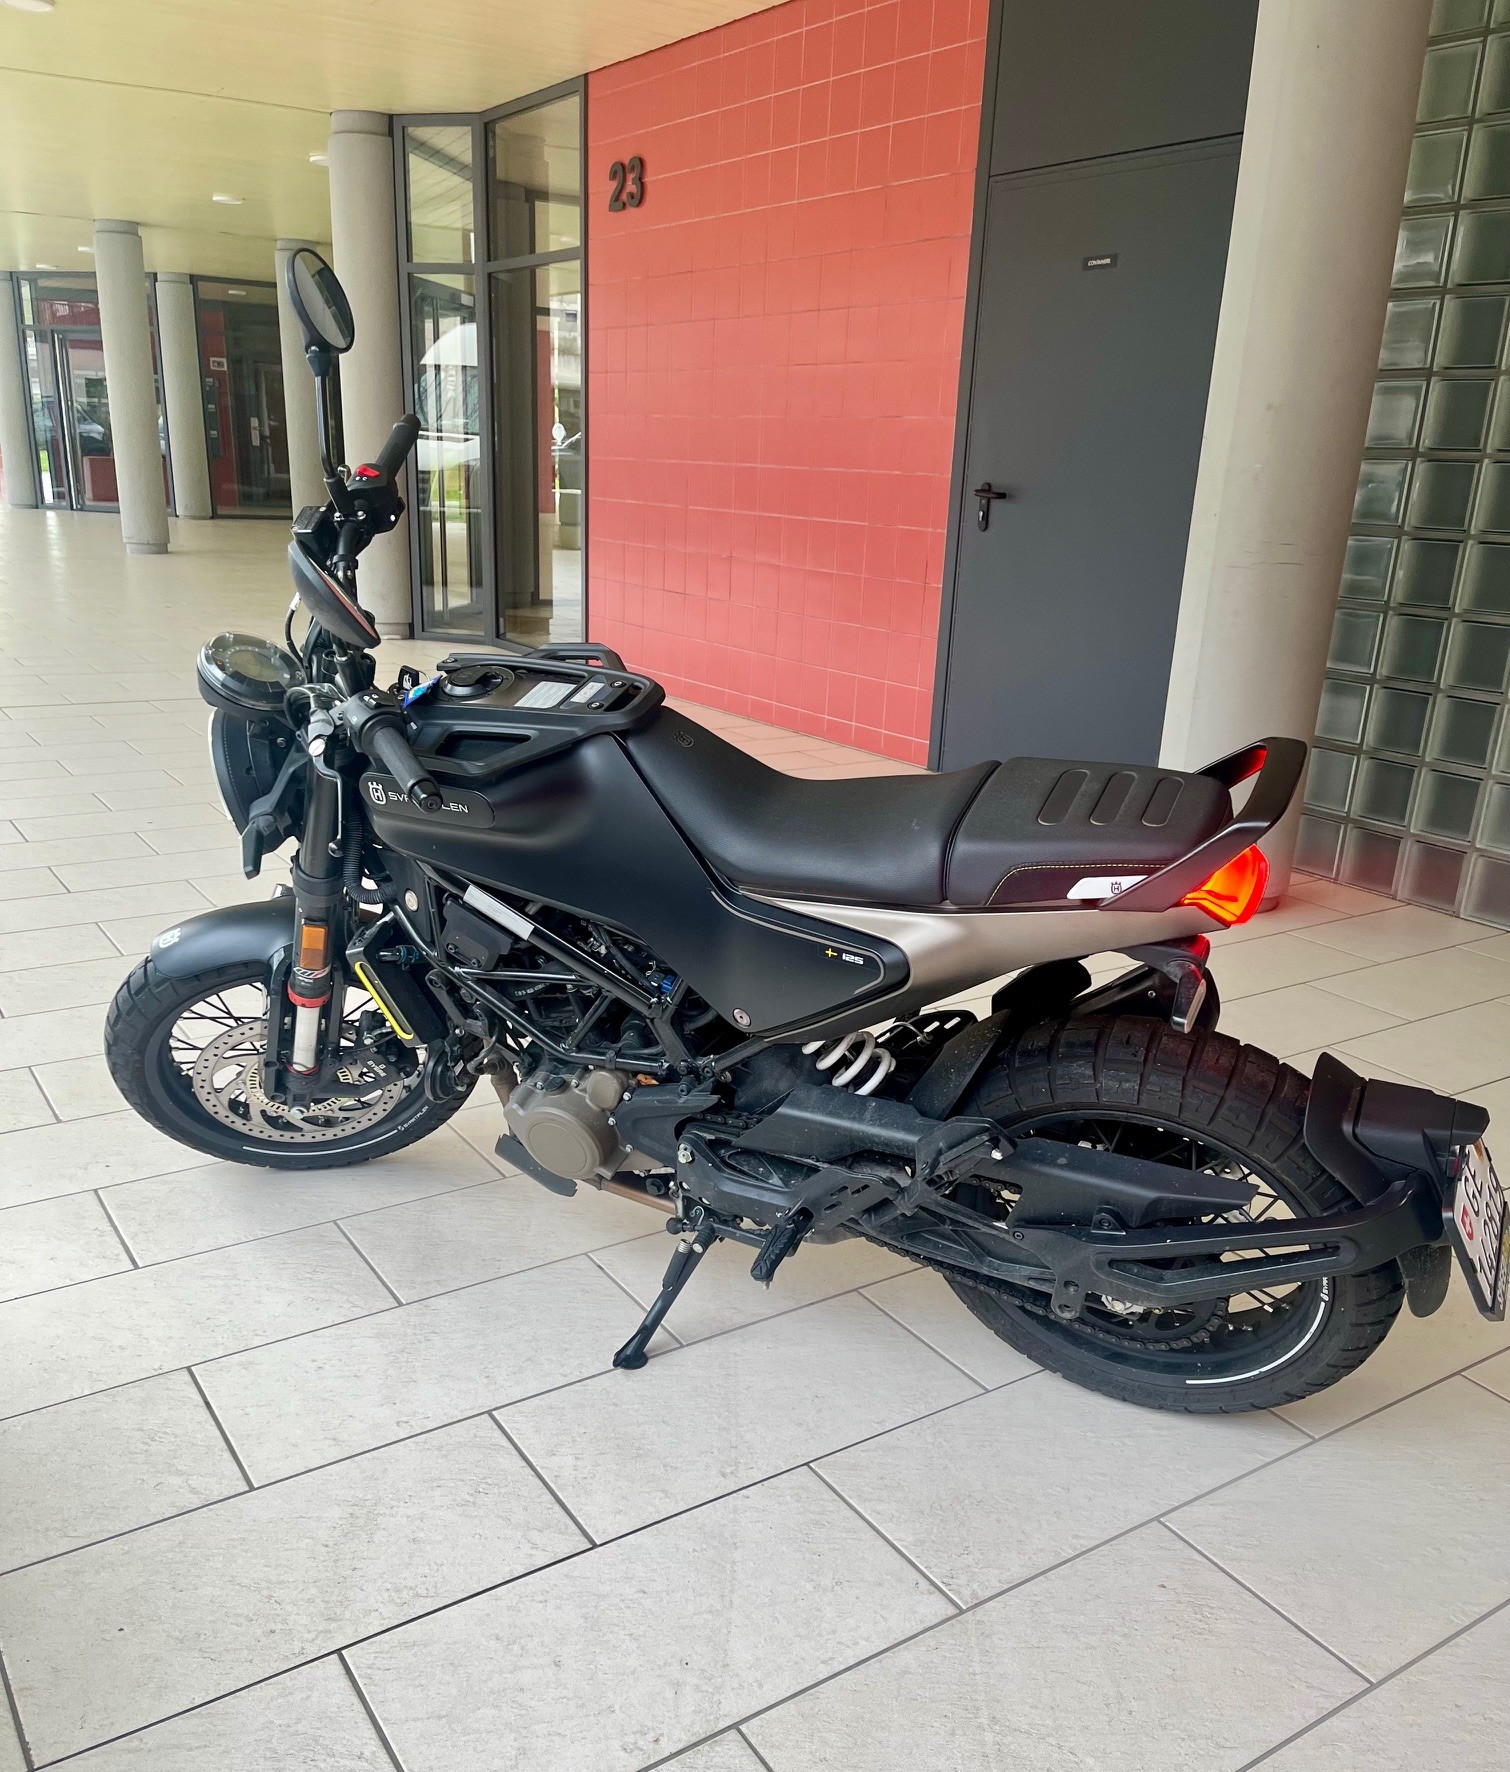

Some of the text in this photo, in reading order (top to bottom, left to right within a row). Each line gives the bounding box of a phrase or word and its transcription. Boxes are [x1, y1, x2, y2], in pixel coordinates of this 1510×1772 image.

[608, 156, 644, 212] 23
[842, 953, 864, 965] 125
[1463, 1164, 1482, 1218] GE
